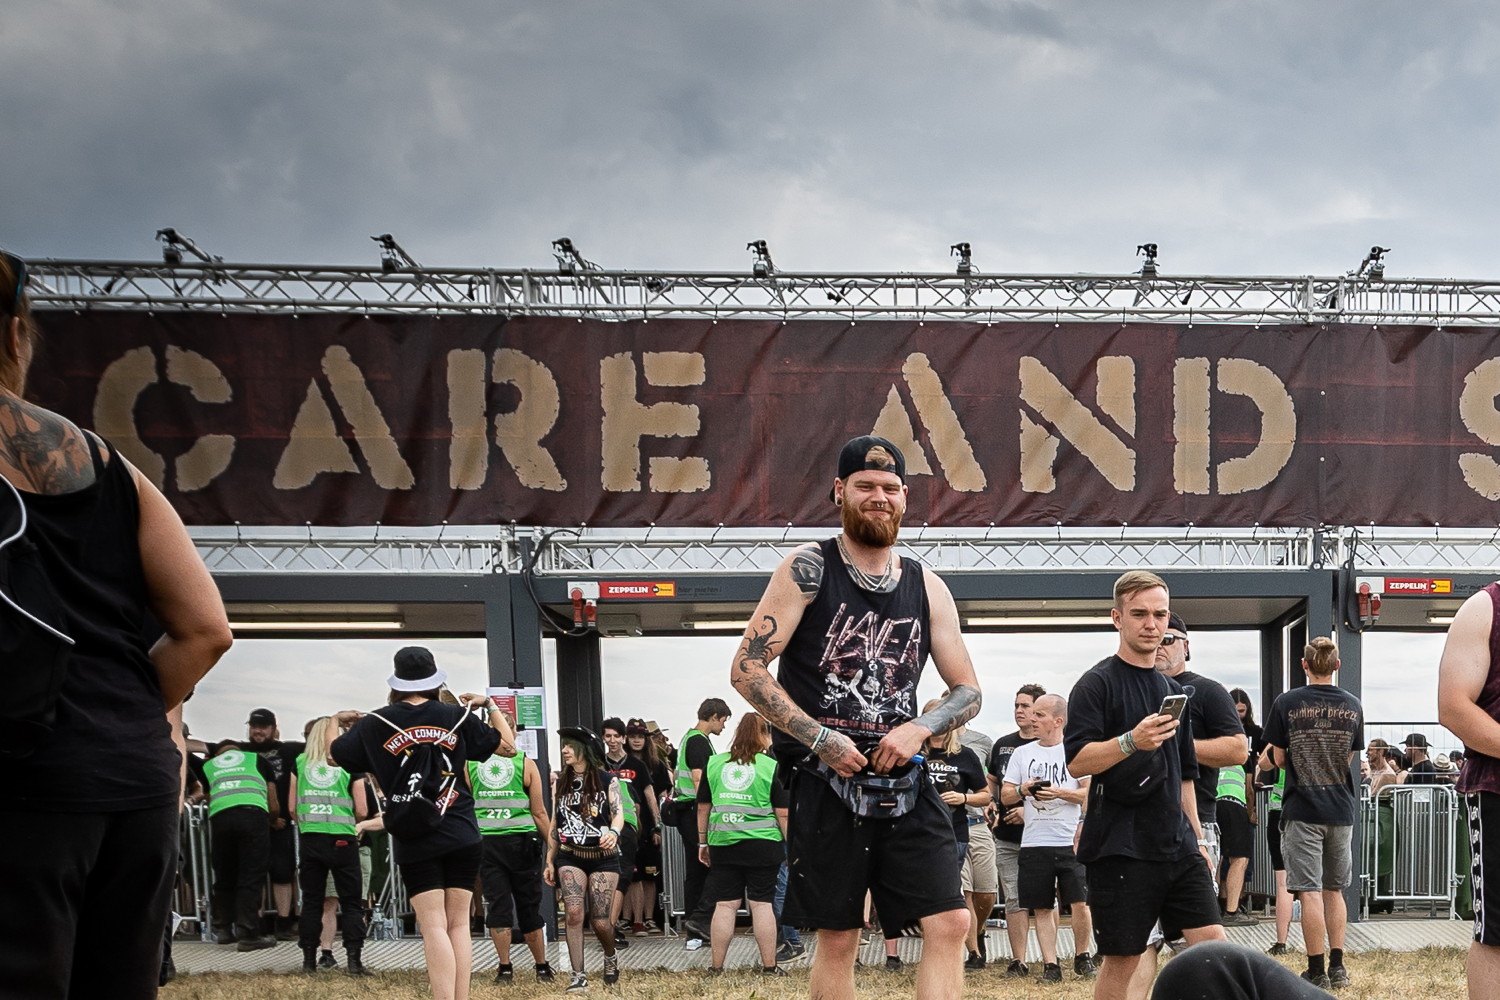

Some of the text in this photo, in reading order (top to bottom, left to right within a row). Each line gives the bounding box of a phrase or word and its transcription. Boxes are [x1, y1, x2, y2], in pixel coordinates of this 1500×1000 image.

[94, 344, 712, 492] CARE
[872, 351, 1297, 497] AND
[608, 586, 649, 594] ZEPPELIN
[1389, 582, 1427, 590] ZEPPELIN
[819, 603, 921, 668] SLAYER
[219, 780, 241, 789] 457
[719, 792, 753, 801] SECURITY
[310, 803, 333, 815] 223
[486, 808, 512, 819] 273
[721, 812, 745, 824] 662
